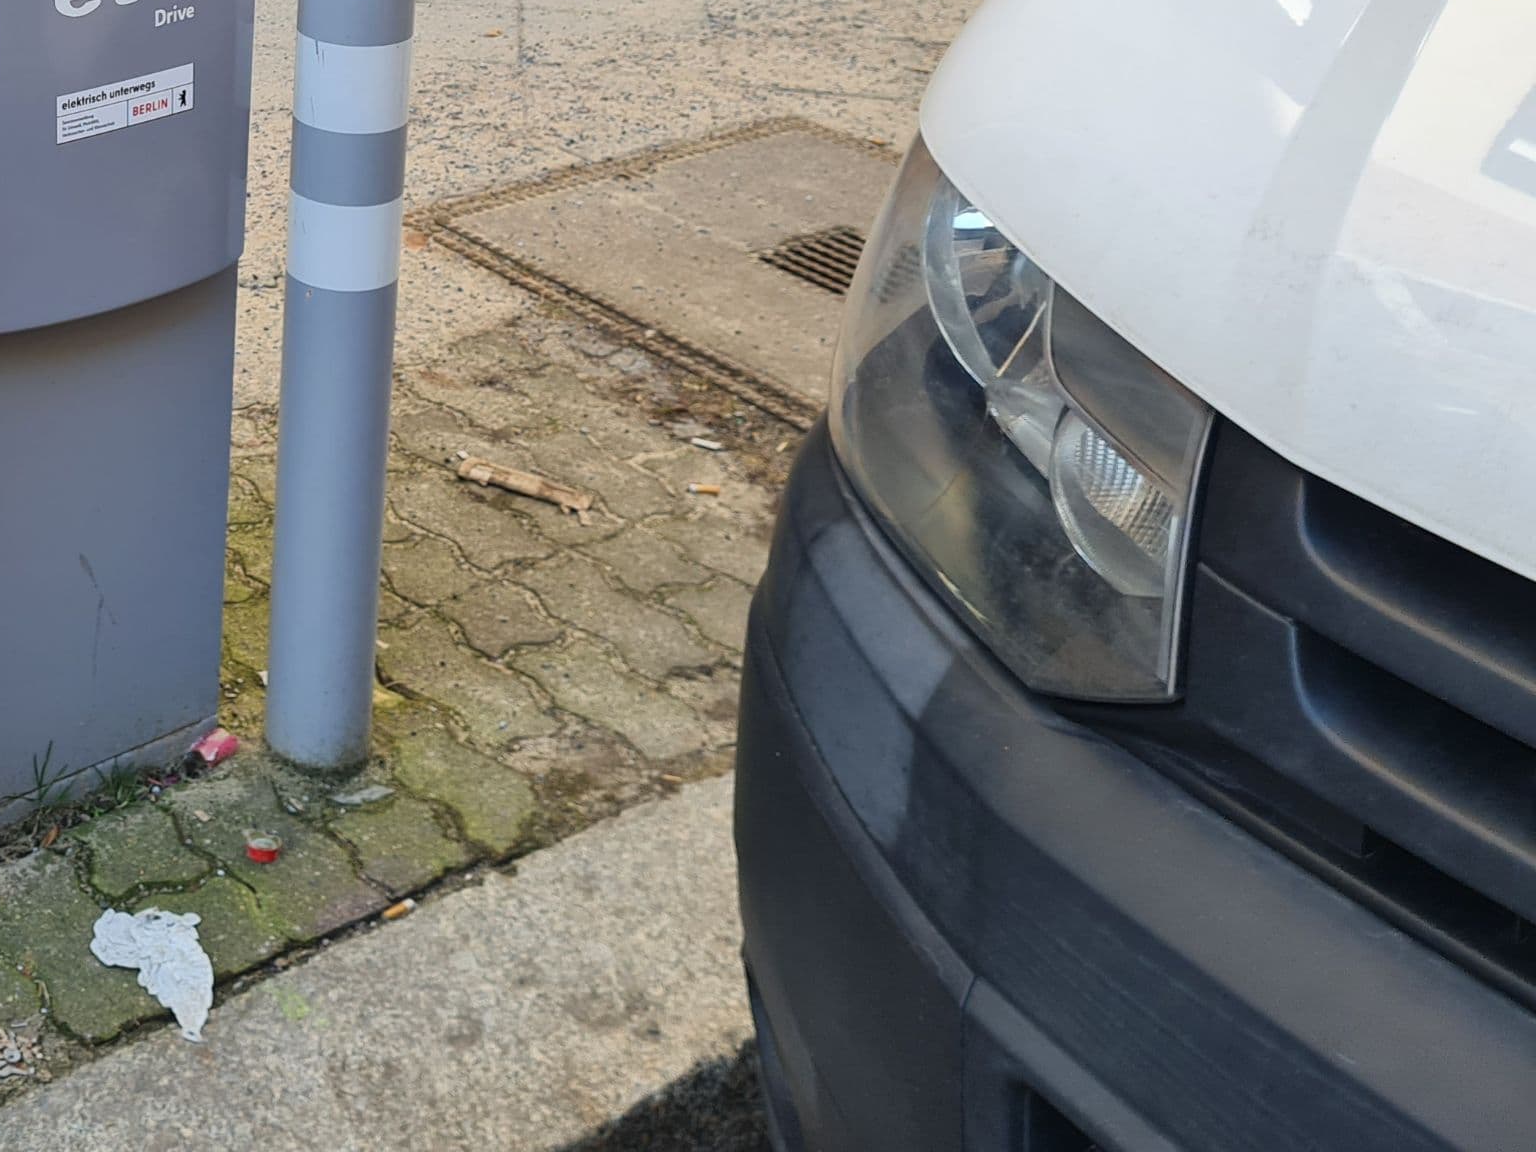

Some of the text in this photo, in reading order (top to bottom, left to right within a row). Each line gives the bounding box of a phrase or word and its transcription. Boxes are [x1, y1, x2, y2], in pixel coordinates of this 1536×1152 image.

[154, 5, 195, 27] Drive
[61, 80, 156, 110] elektrisch unterwegs
[132, 98, 169, 117] BERLIN
